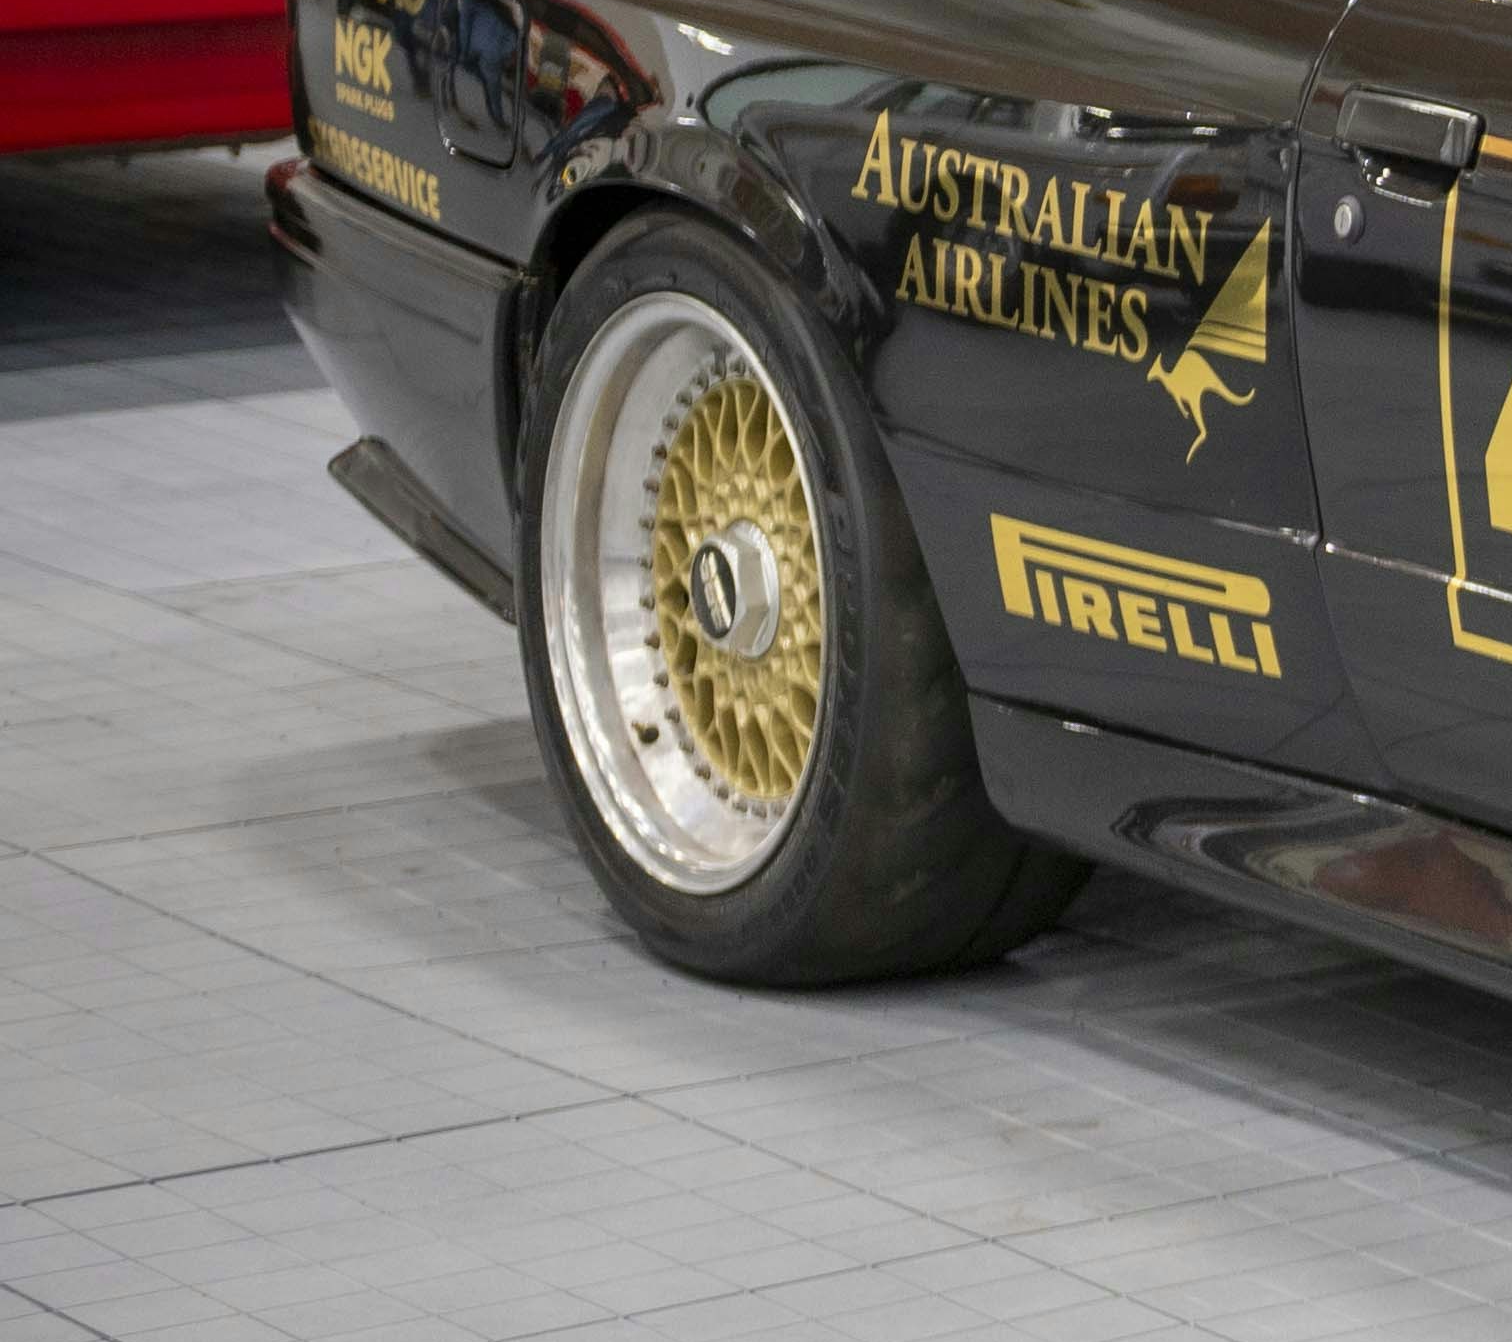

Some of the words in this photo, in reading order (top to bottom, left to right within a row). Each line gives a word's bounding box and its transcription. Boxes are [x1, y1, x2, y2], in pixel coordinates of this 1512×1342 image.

[335, 17, 393, 95] NGK
[851, 108, 1212, 286] AUSTRALIAN
[895, 232, 1150, 363] AIRLINES
[990, 512, 1283, 680] PIRELLI
